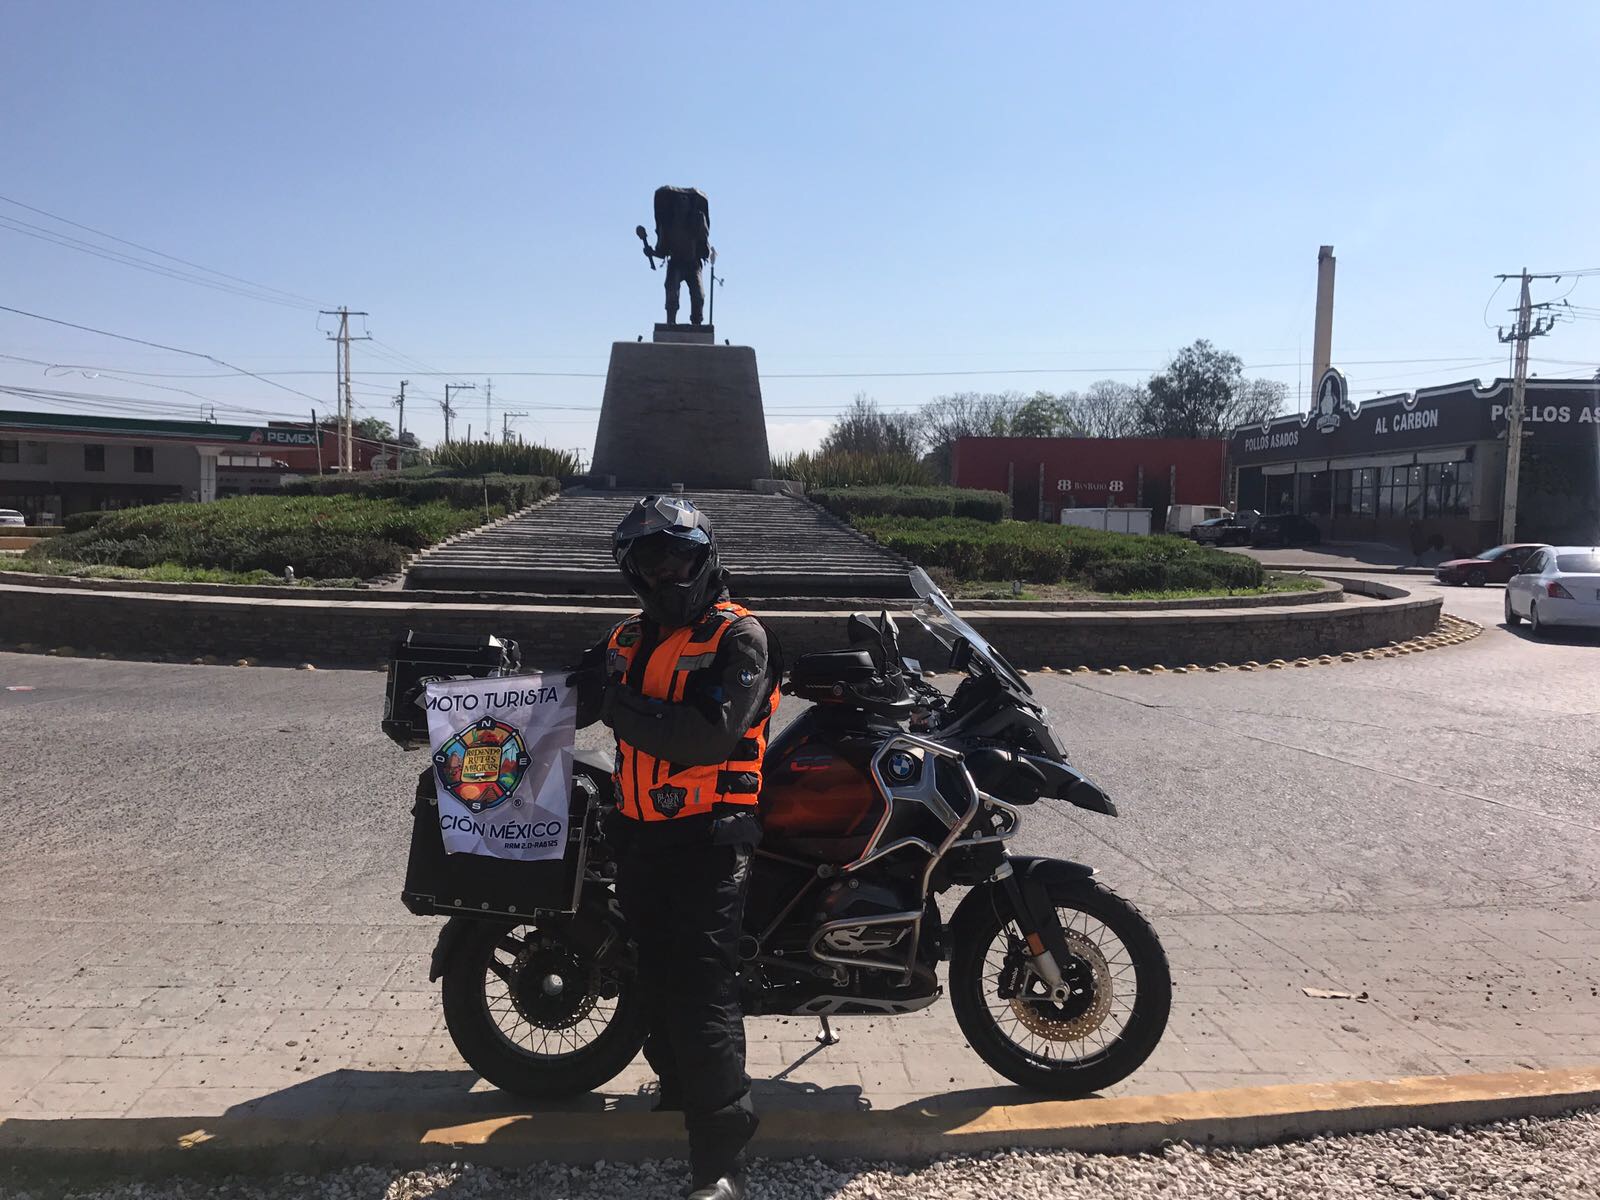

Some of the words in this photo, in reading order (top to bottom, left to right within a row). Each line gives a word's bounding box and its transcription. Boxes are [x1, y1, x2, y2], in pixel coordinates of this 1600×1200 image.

[1375, 417, 1388, 434] AL
[1393, 409, 1438, 432] CARBON
[267, 432, 316, 444] PEMEX
[1245, 435, 1269, 452] POLLOS
[1270, 431, 1299, 449] ASADOS
[425, 694, 479, 712] MOTO
[484, 686, 558, 710] TURISTA
[519, 757, 527, 766] E
[472, 802, 481, 810] S
[440, 815, 485, 836] CIÓN
[489, 820, 562, 840] MÉXICO
